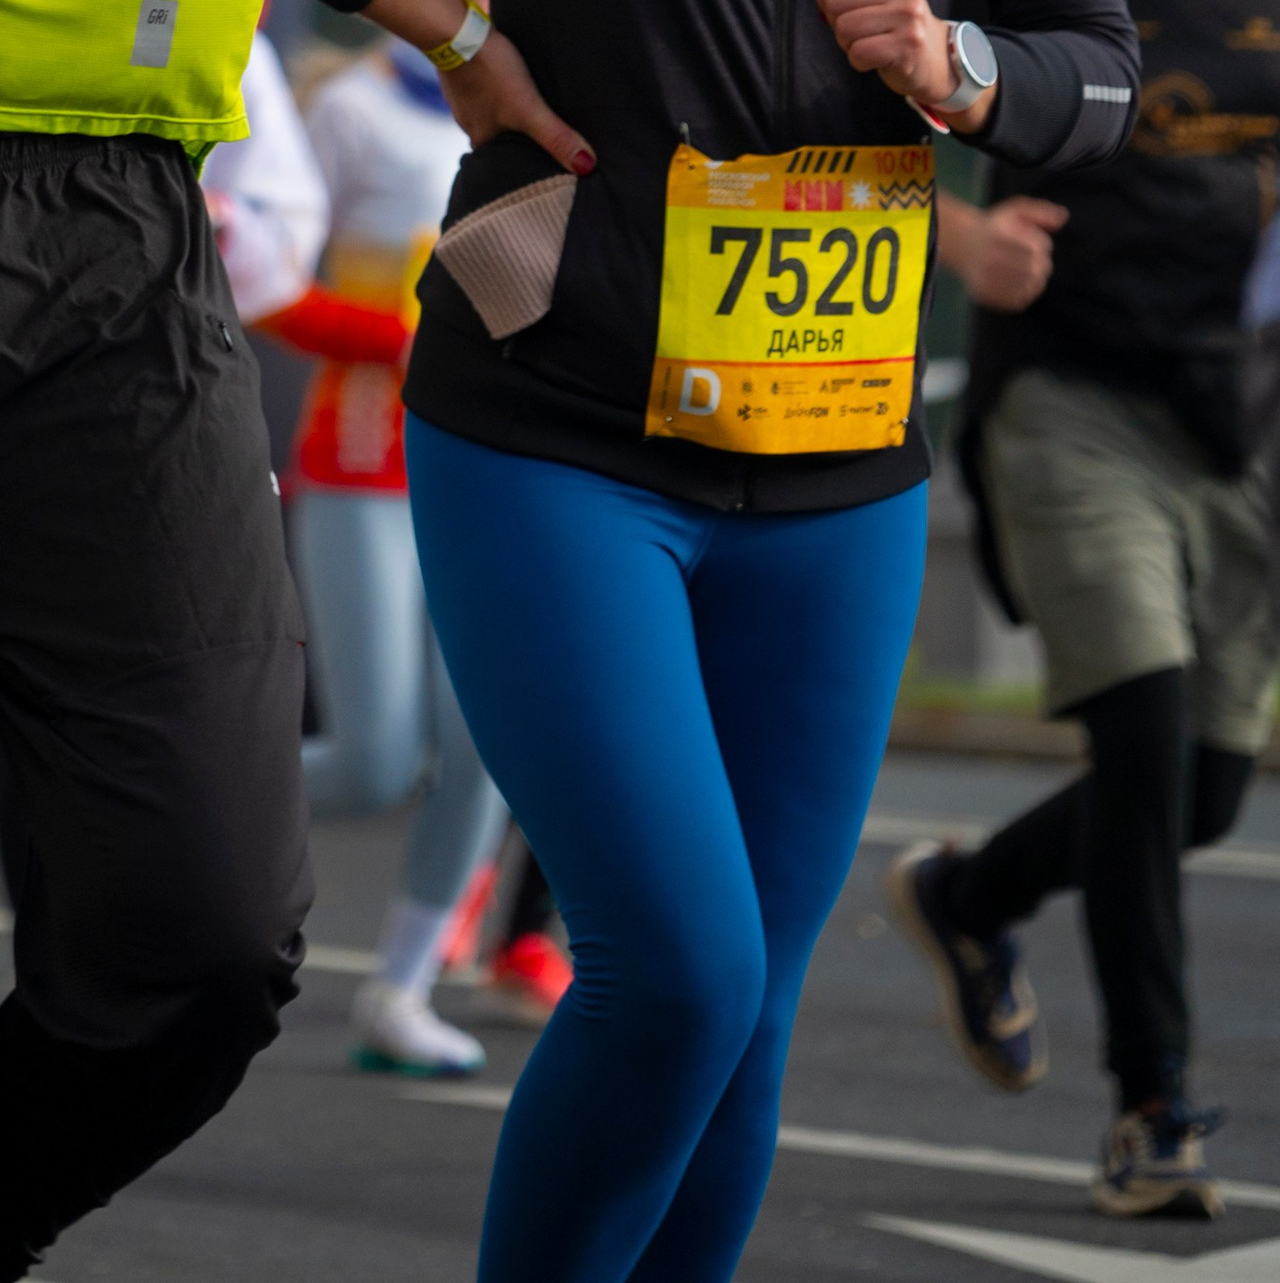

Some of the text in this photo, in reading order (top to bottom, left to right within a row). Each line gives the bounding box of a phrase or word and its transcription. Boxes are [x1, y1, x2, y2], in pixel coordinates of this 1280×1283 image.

[874, 151, 895, 175] 10
[709, 226, 901, 317] 7520
[767, 328, 845, 359] ДАРЬЯ
[678, 367, 721, 417] D
